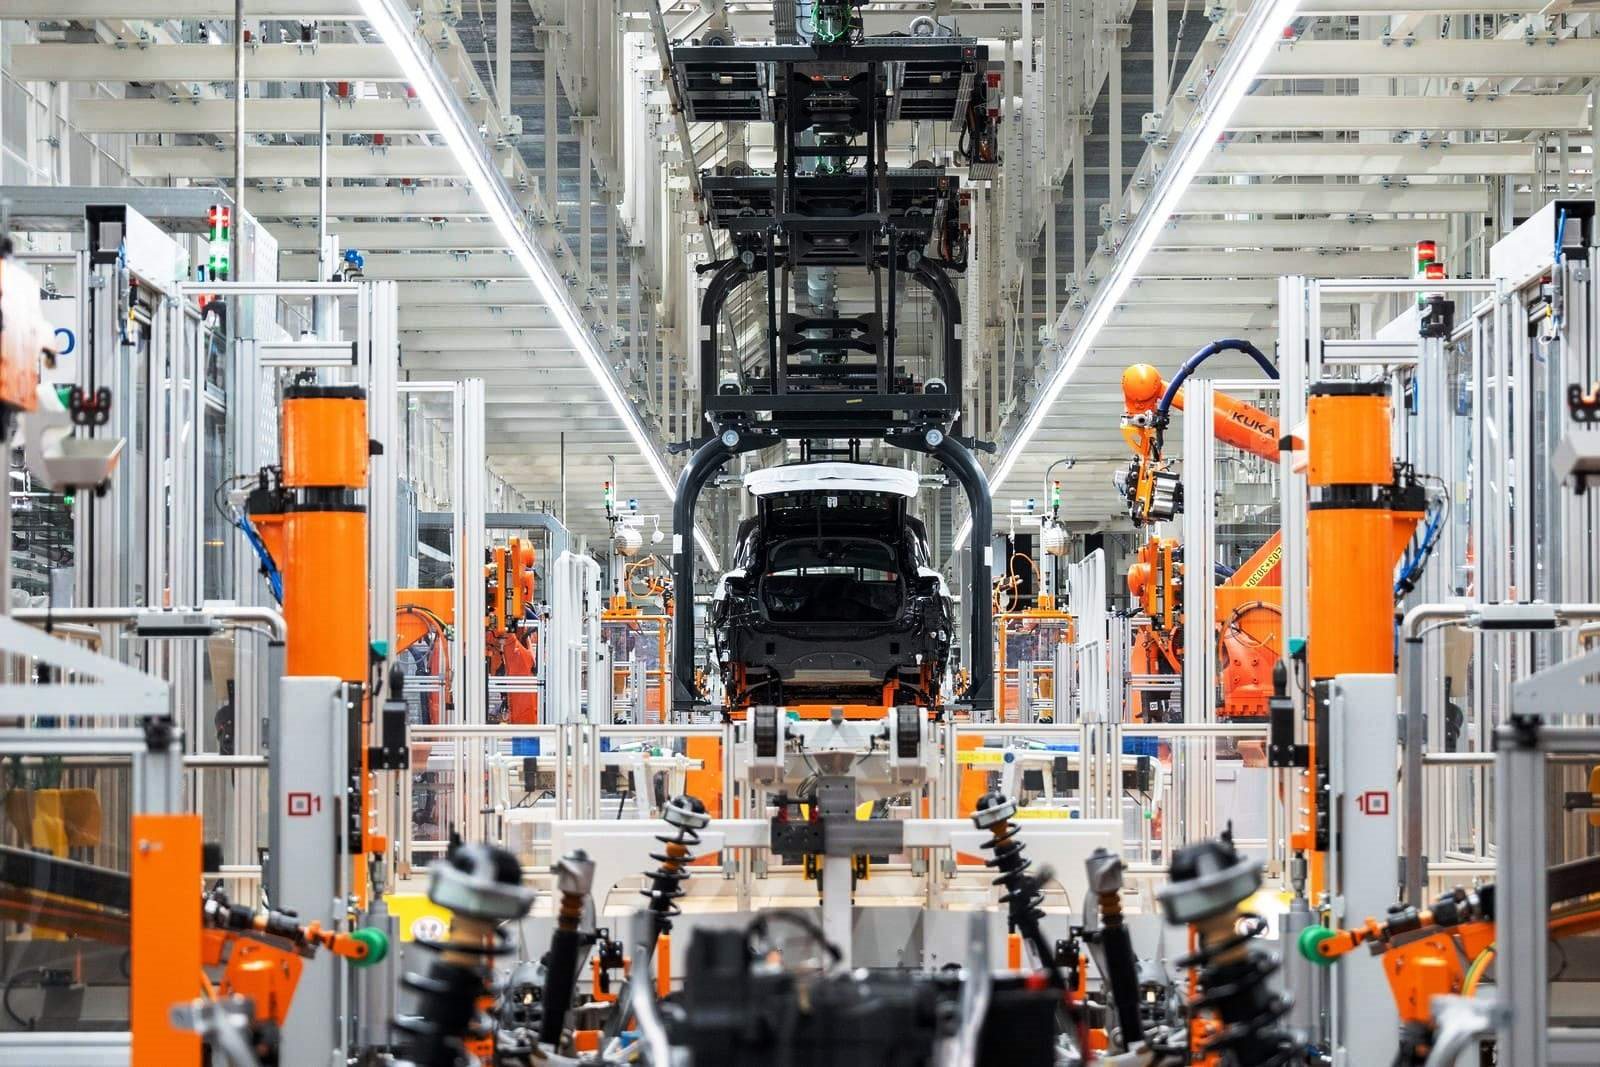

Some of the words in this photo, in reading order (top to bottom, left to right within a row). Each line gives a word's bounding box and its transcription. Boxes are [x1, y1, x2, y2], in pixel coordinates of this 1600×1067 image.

[1233, 412, 1274, 438] KUKA
[312, 795, 320, 812] 1
[1355, 795, 1363, 812] 1
